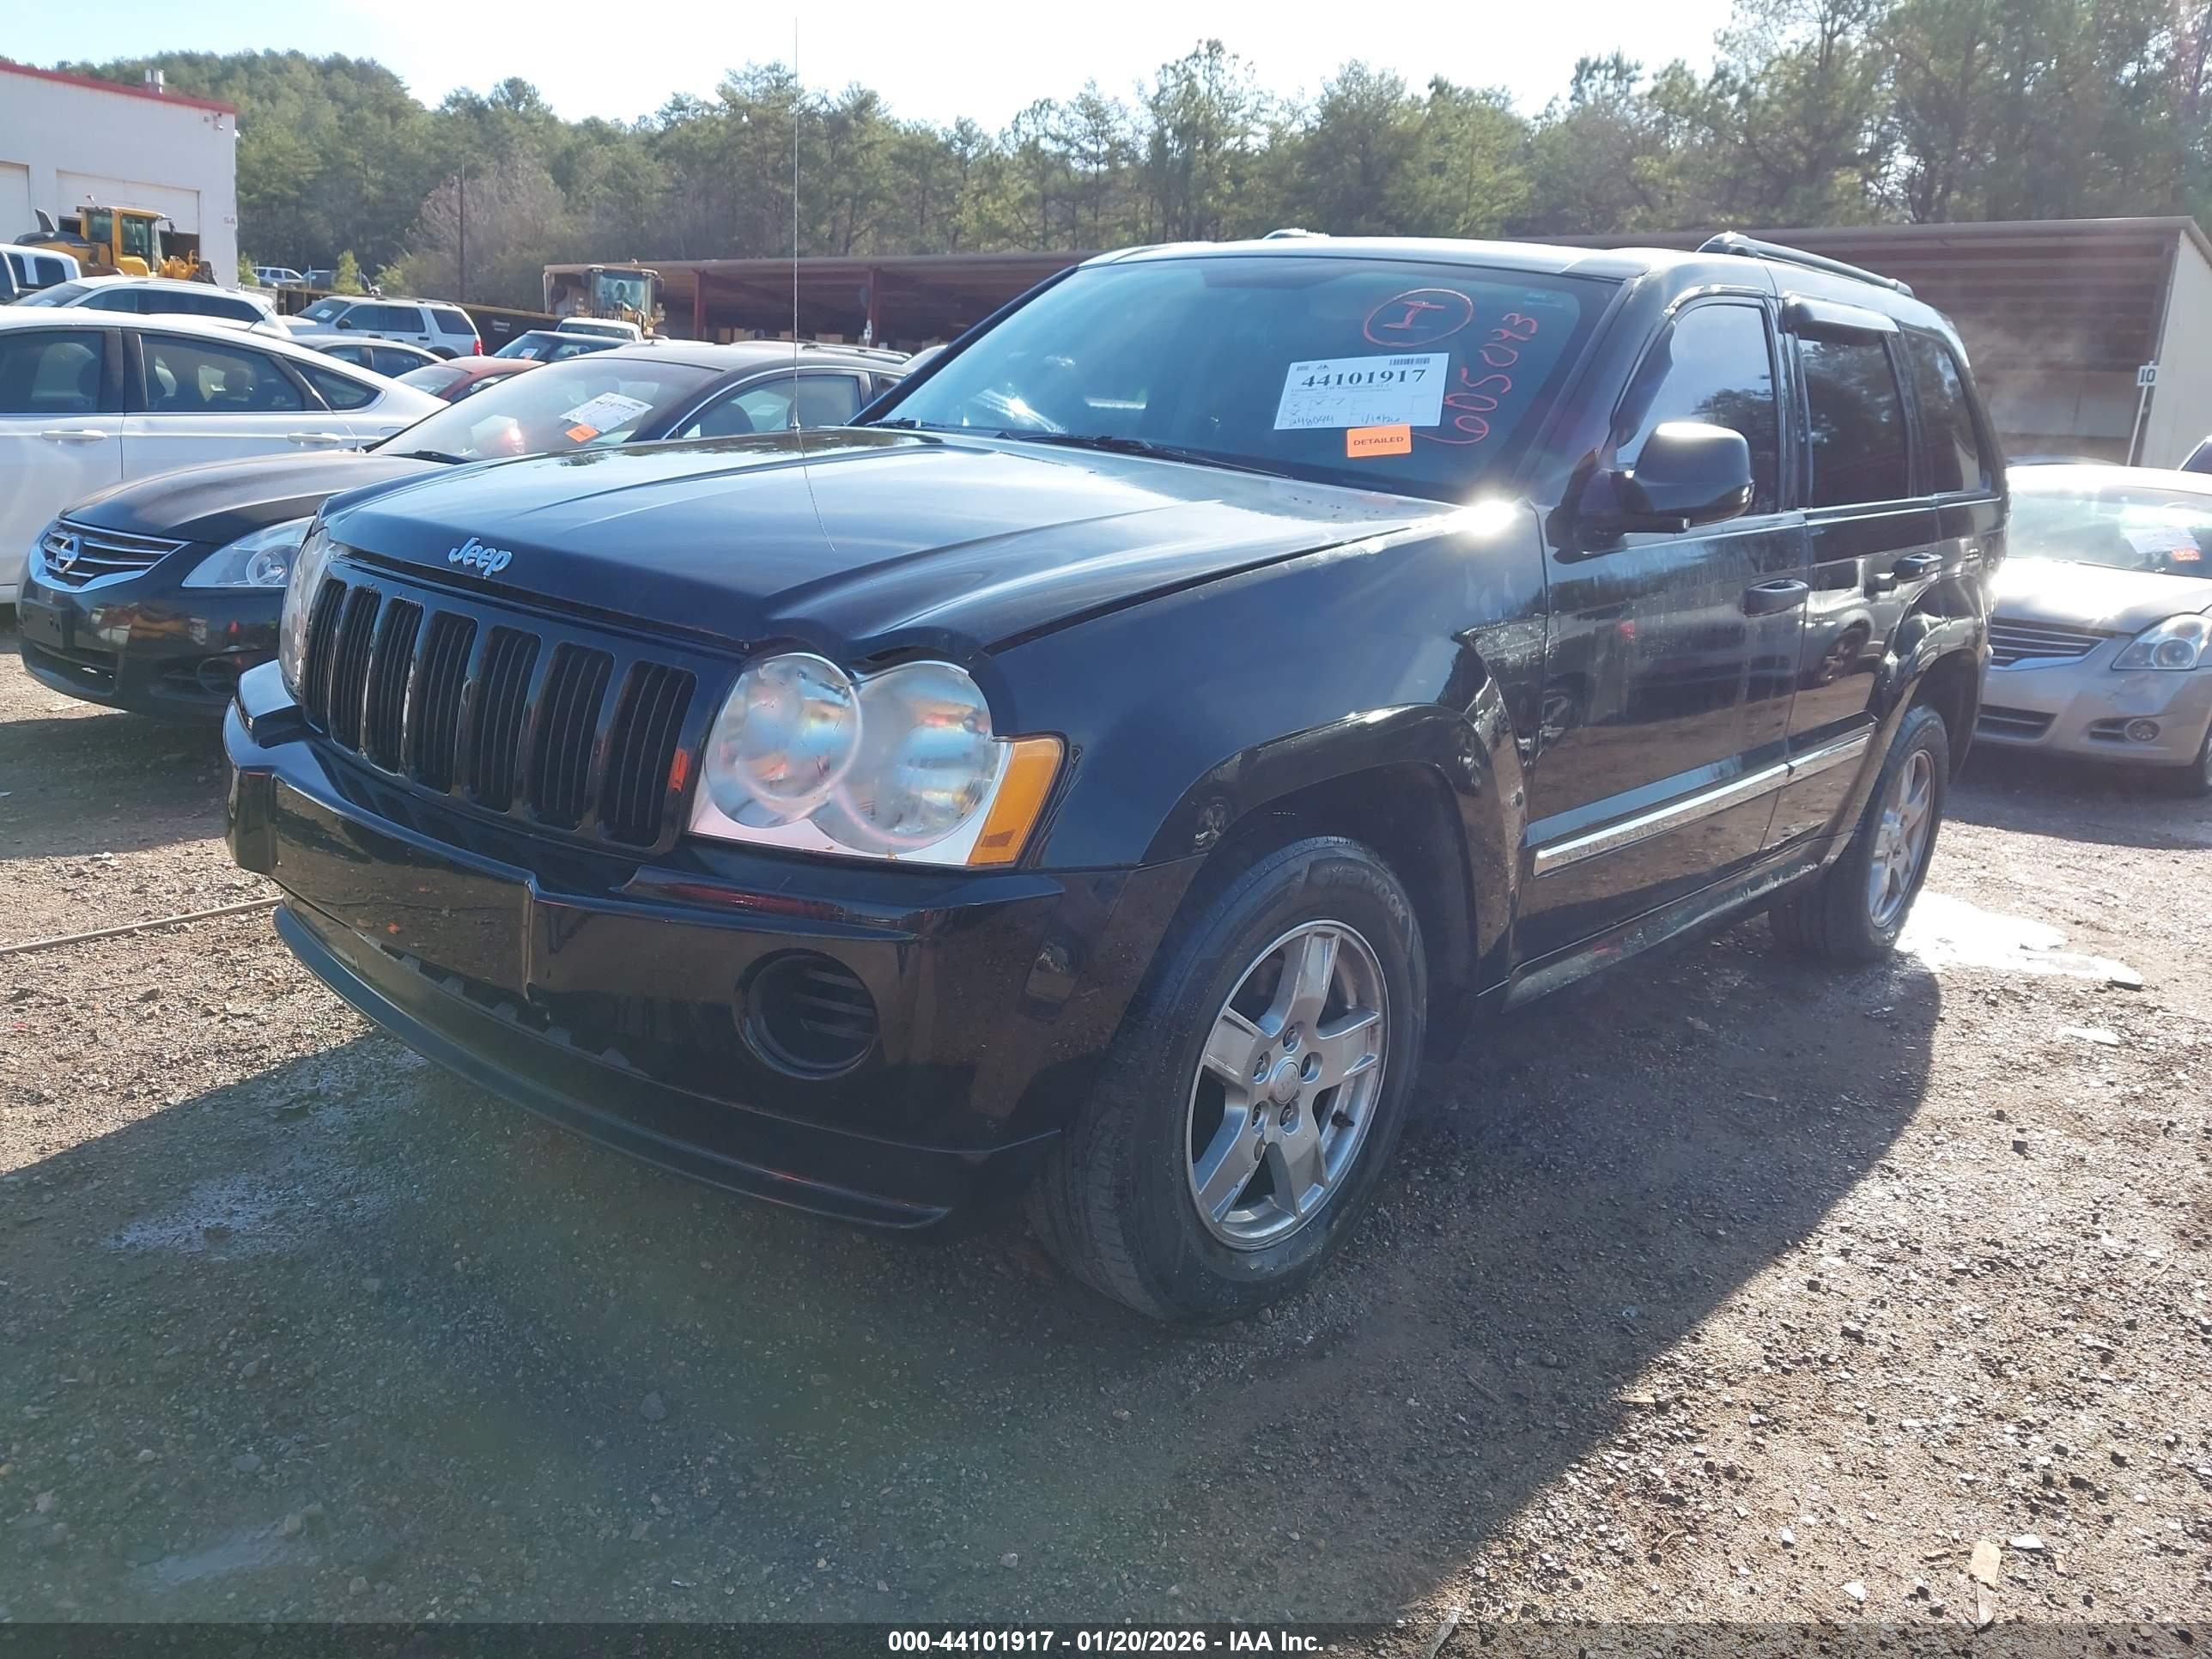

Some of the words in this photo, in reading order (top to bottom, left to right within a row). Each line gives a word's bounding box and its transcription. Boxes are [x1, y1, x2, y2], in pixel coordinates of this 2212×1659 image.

[1301, 369, 1426, 387] 44101917
[2140, 368, 2156, 383] 10
[1353, 436, 1404, 446] DETAILED
[448, 537, 513, 577] Jeep
